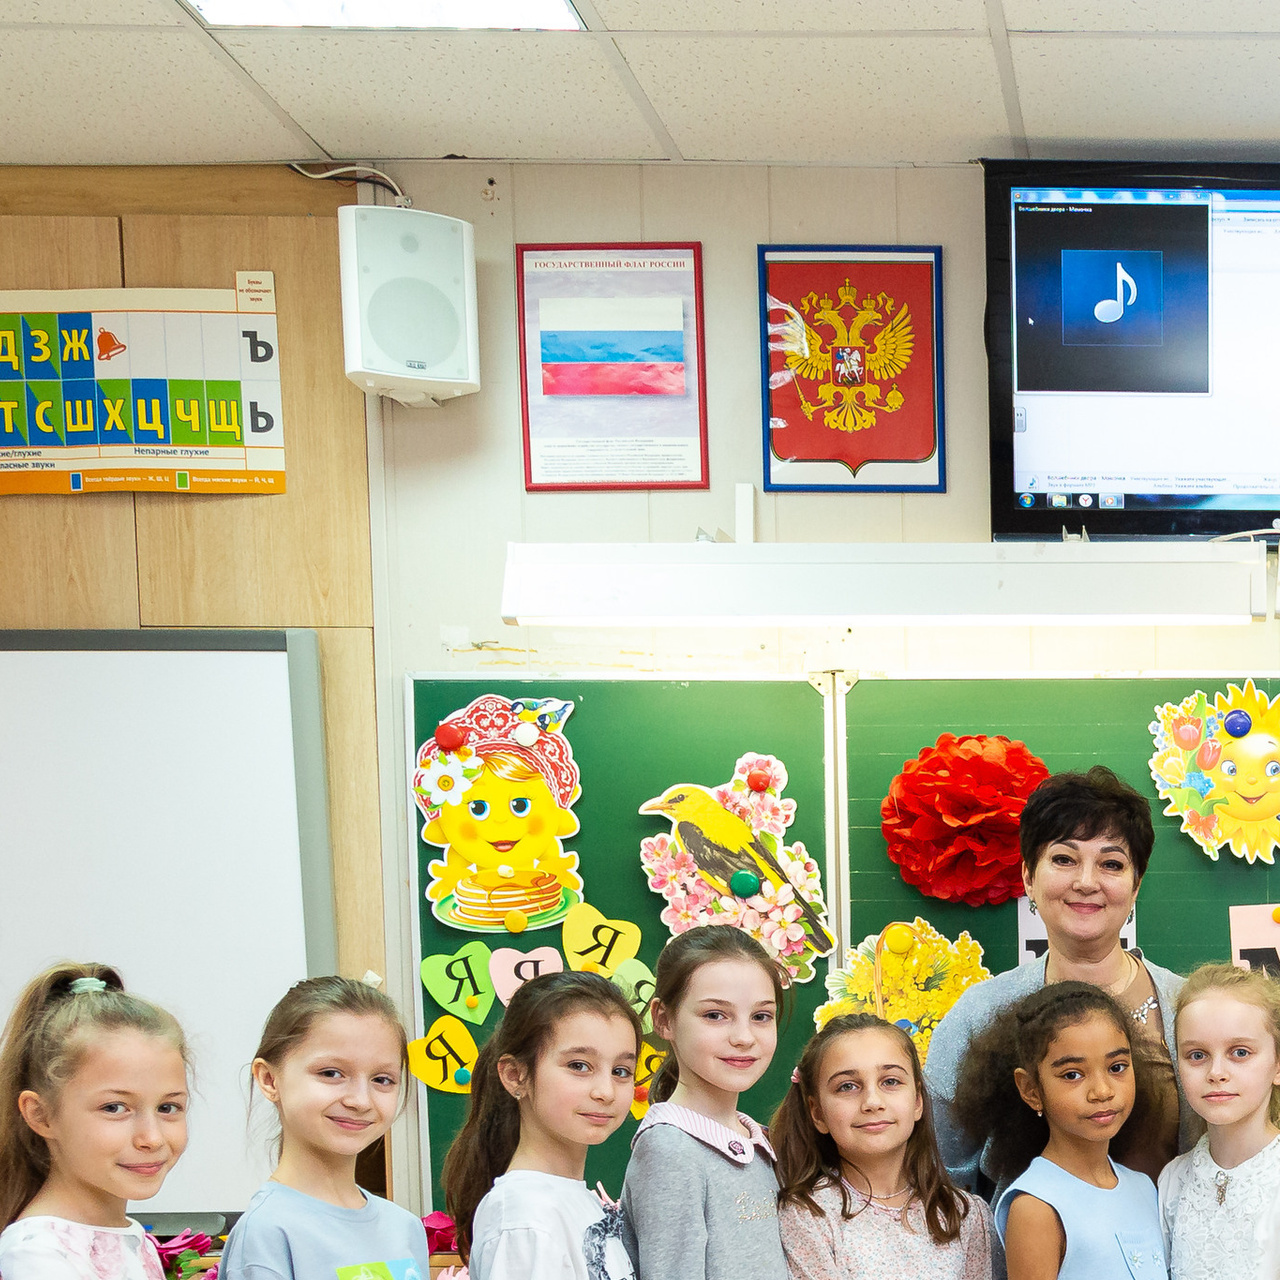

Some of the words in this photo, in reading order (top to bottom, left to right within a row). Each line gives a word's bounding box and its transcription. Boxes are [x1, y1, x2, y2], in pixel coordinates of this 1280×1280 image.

[534, 260, 622, 269] ГОСУДАРСТВЕННЫЙ
[623, 260, 649, 268] ФЛАГ
[649, 260, 686, 268] РОССИИ
[30, 329, 51, 363] З
[61, 328, 91, 362] Ж
[242, 330, 274, 363] Ъ
[35, 400, 54, 433] С
[65, 399, 95, 433] Ш
[103, 398, 128, 431] Х
[137, 398, 165, 440] Ц
[175, 399, 201, 433] Ч
[208, 399, 243, 442] Щ
[249, 401, 275, 433] Ь
[31, 462, 56, 470] звуки
[133, 446, 178, 456] Непарные
[181, 448, 210, 458] глухие
[574, 924, 626, 969] Я
[445, 954, 486, 1005] Я
[425, 1030, 472, 1085] Я
